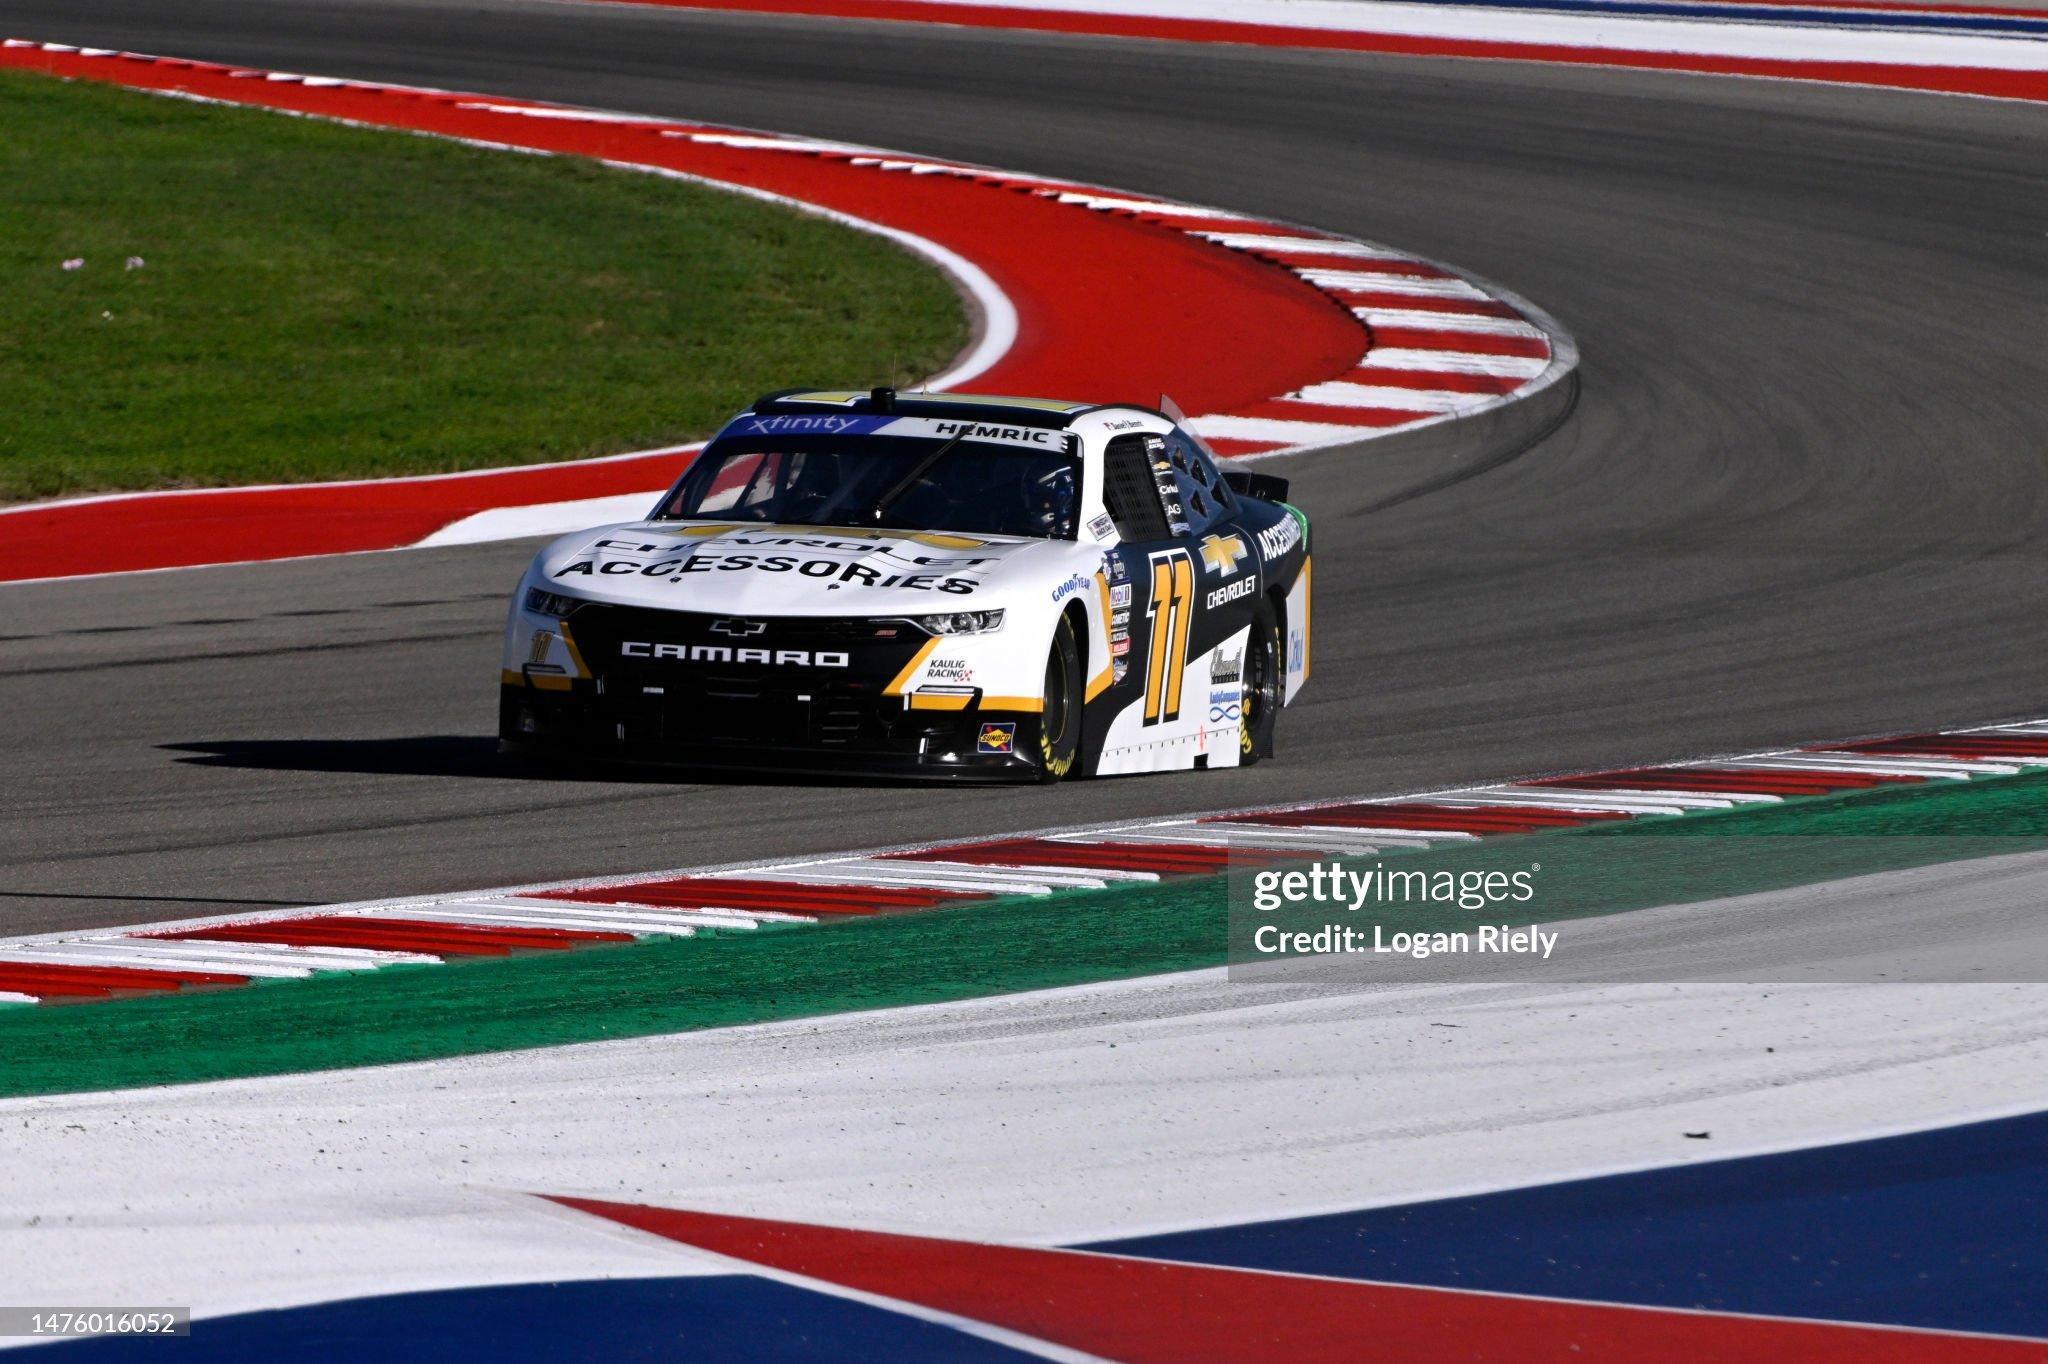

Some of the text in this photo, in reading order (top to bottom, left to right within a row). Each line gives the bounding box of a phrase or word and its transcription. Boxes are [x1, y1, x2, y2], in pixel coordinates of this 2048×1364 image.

[747, 416, 858, 434] xfinity
[935, 421, 1048, 444] HEMRIC
[552, 555, 980, 594] ACCESSORIES
[1052, 573, 1090, 602] GOODYEAR
[1207, 574, 1256, 610] CHEVROLET
[1143, 547, 1196, 728] 11
[622, 641, 849, 668] CAMARO
[930, 659, 965, 668] KAULIG
[927, 669, 963, 678] RACING
[982, 733, 1011, 743] SUNOCO
